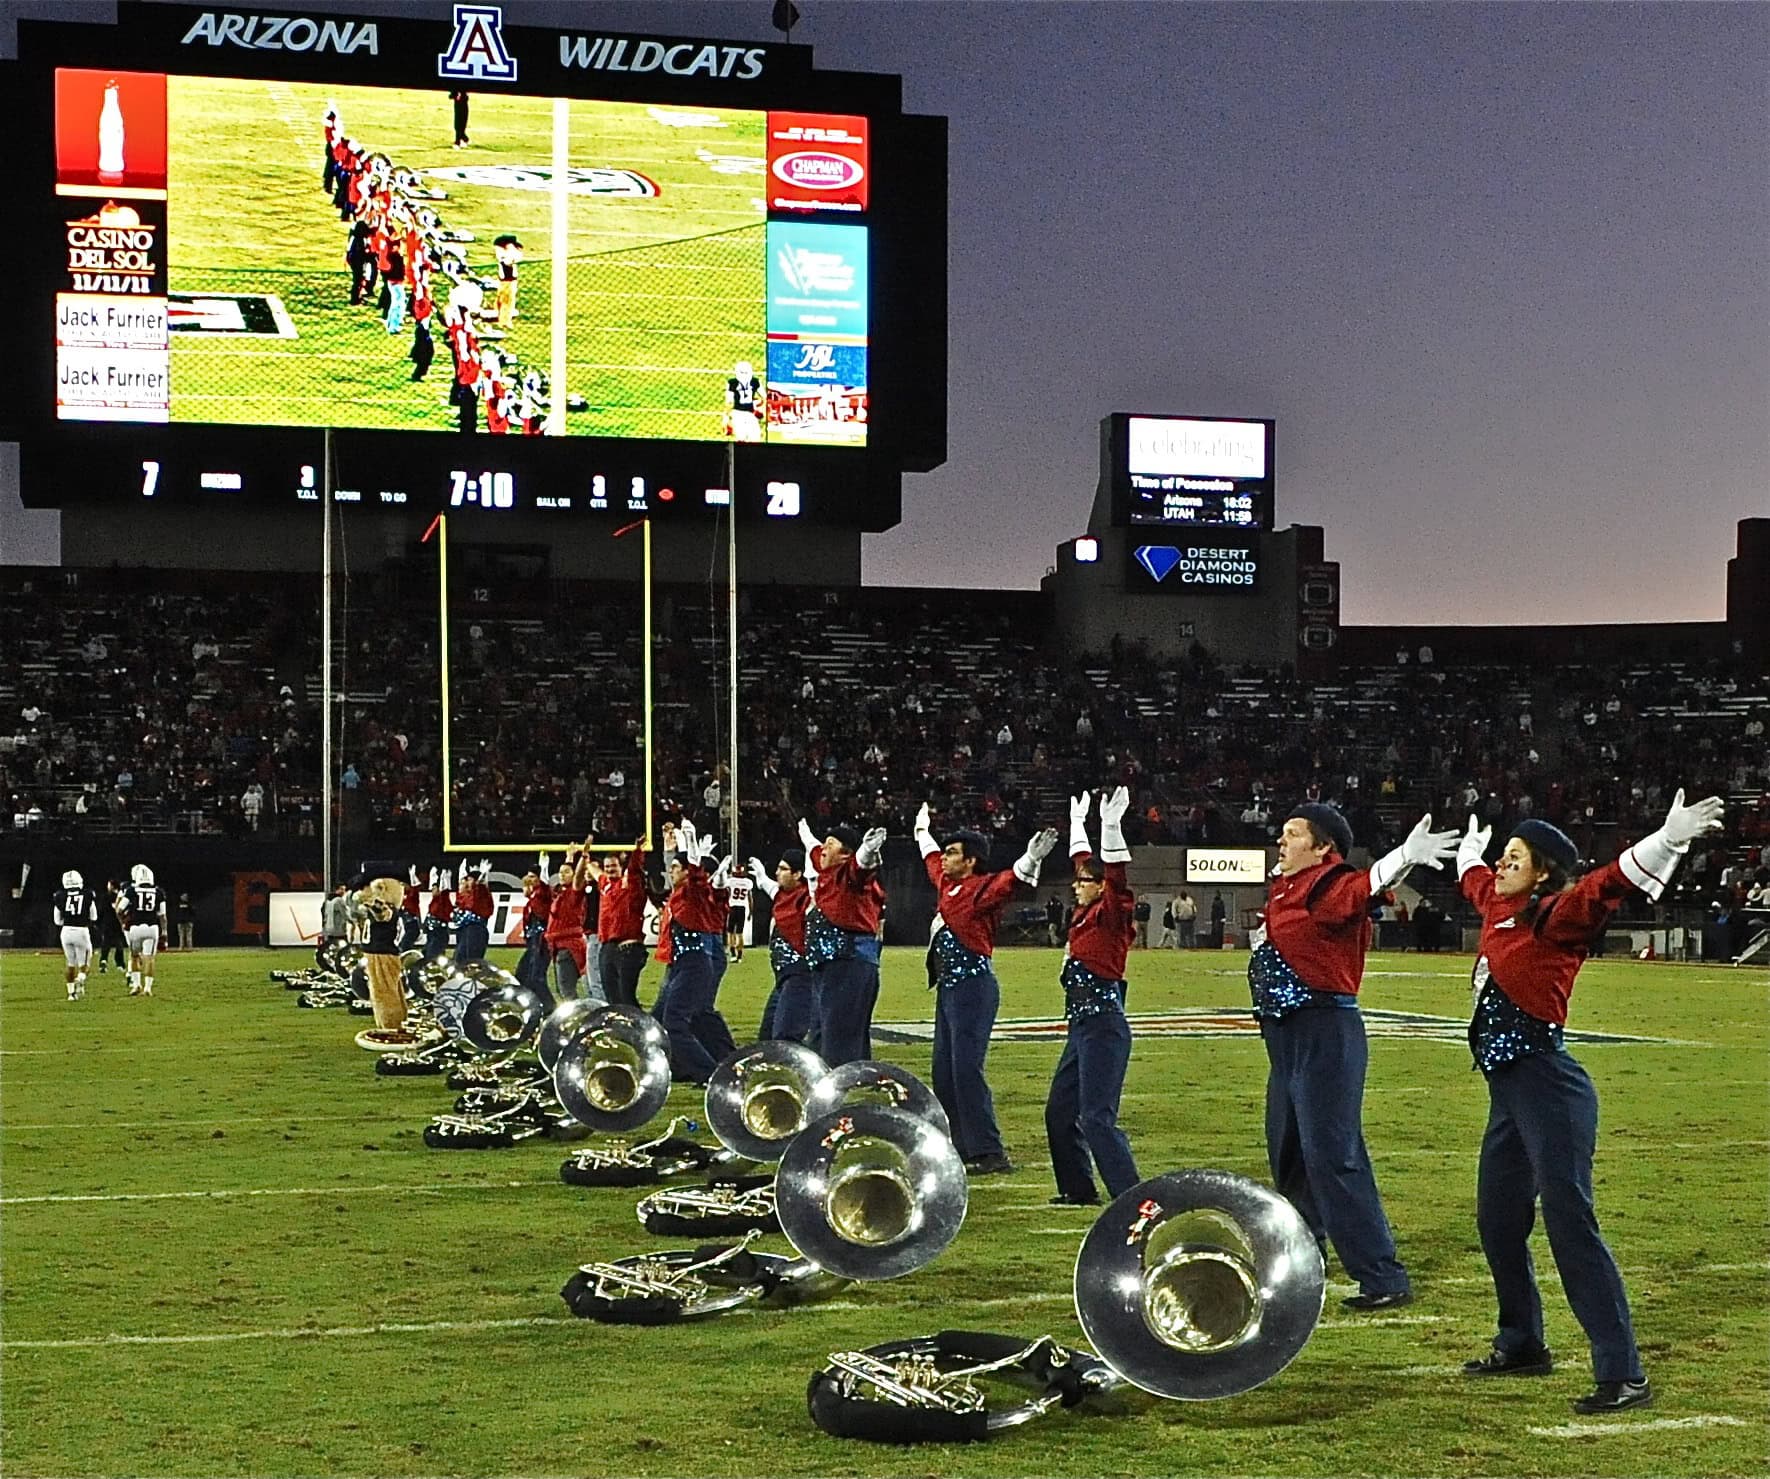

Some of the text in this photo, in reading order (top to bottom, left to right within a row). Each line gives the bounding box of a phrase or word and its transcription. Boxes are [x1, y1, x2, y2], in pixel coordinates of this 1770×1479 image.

[181, 12, 378, 55] ARIZONA
[438, 4, 517, 81] A
[559, 36, 766, 79] WILDCATS
[791, 159, 844, 175] CHAPMAN
[67, 228, 153, 250] CASINO
[69, 249, 155, 271] DEL SOL
[73, 273, 150, 293] 11/11/11
[60, 306, 163, 329] Jack Furrier
[61, 365, 163, 388] Jack Furrier
[143, 461, 159, 495] 7
[1161, 477, 1175, 489] of
[450, 470, 513, 508] 7:10
[1163, 507, 1195, 520] UTAH
[1187, 547, 1249, 560] DESERT
[1179, 559, 1257, 573] DIAMOND
[1181, 572, 1254, 585] CASINOS
[473, 588, 488, 602] 12
[137, 892, 156, 911] 13
[732, 887, 748, 901] 95
[65, 894, 84, 915] 47
